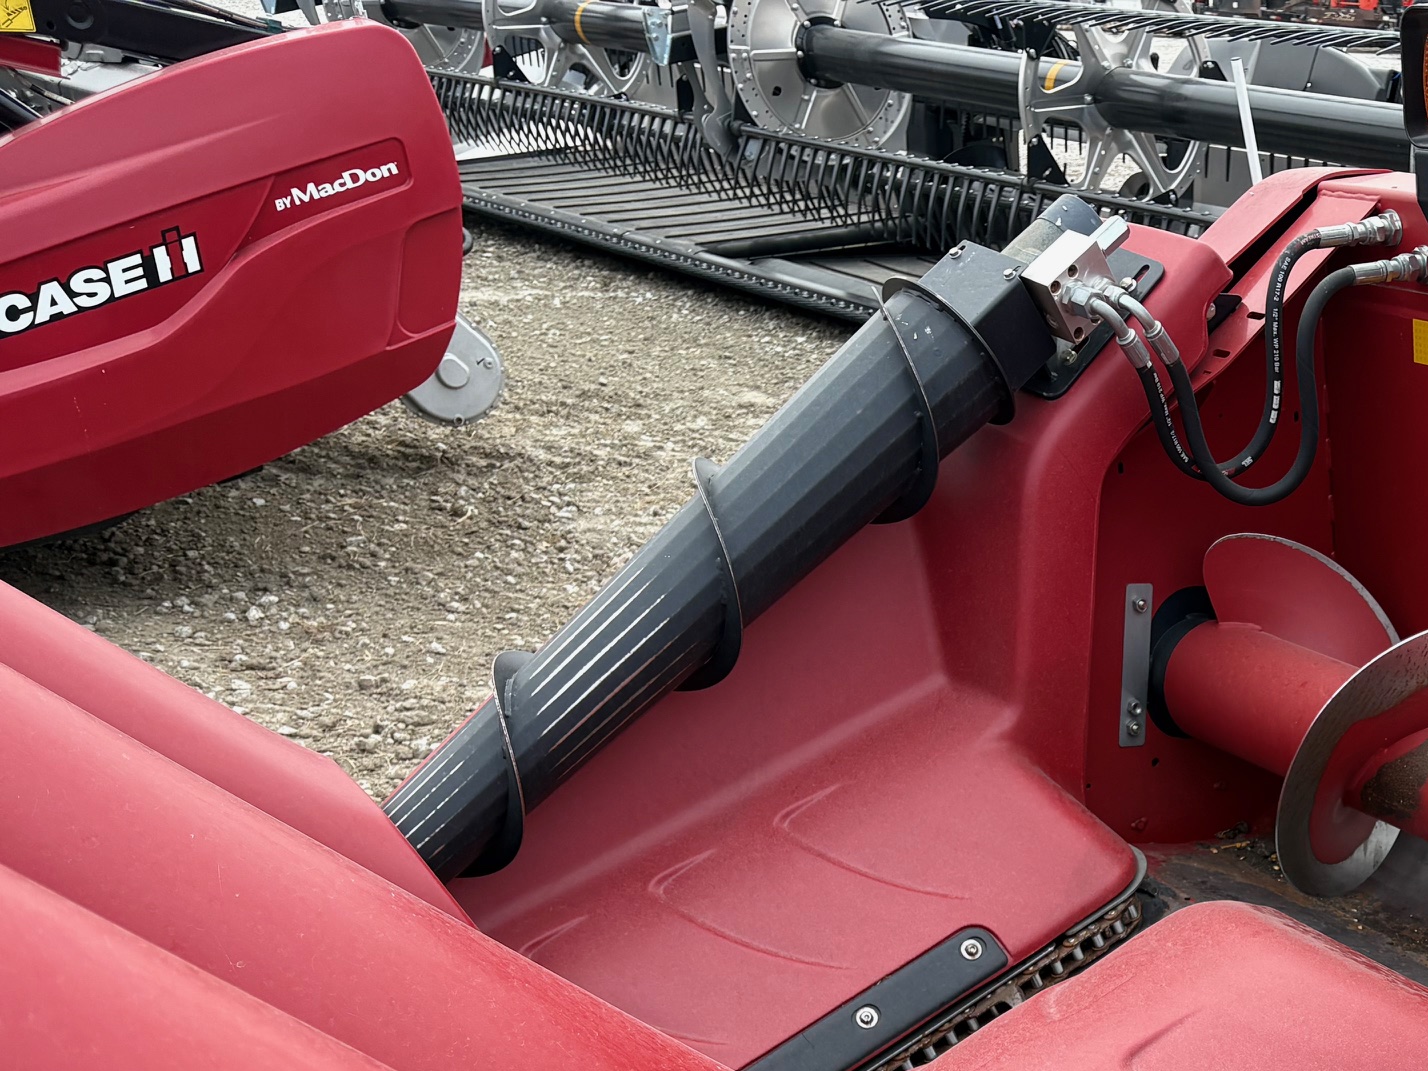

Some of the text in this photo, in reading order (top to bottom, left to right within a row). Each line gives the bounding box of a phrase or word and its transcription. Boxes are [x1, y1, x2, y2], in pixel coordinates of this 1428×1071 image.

[275, 161, 399, 211] BY MacDon
[1281, 256, 1291, 270] SAE
[1277, 270, 1285, 282] 100
[0, 253, 148, 333] CASE
[1273, 282, 1282, 302] R17-2
[1273, 337, 1280, 349] WP
